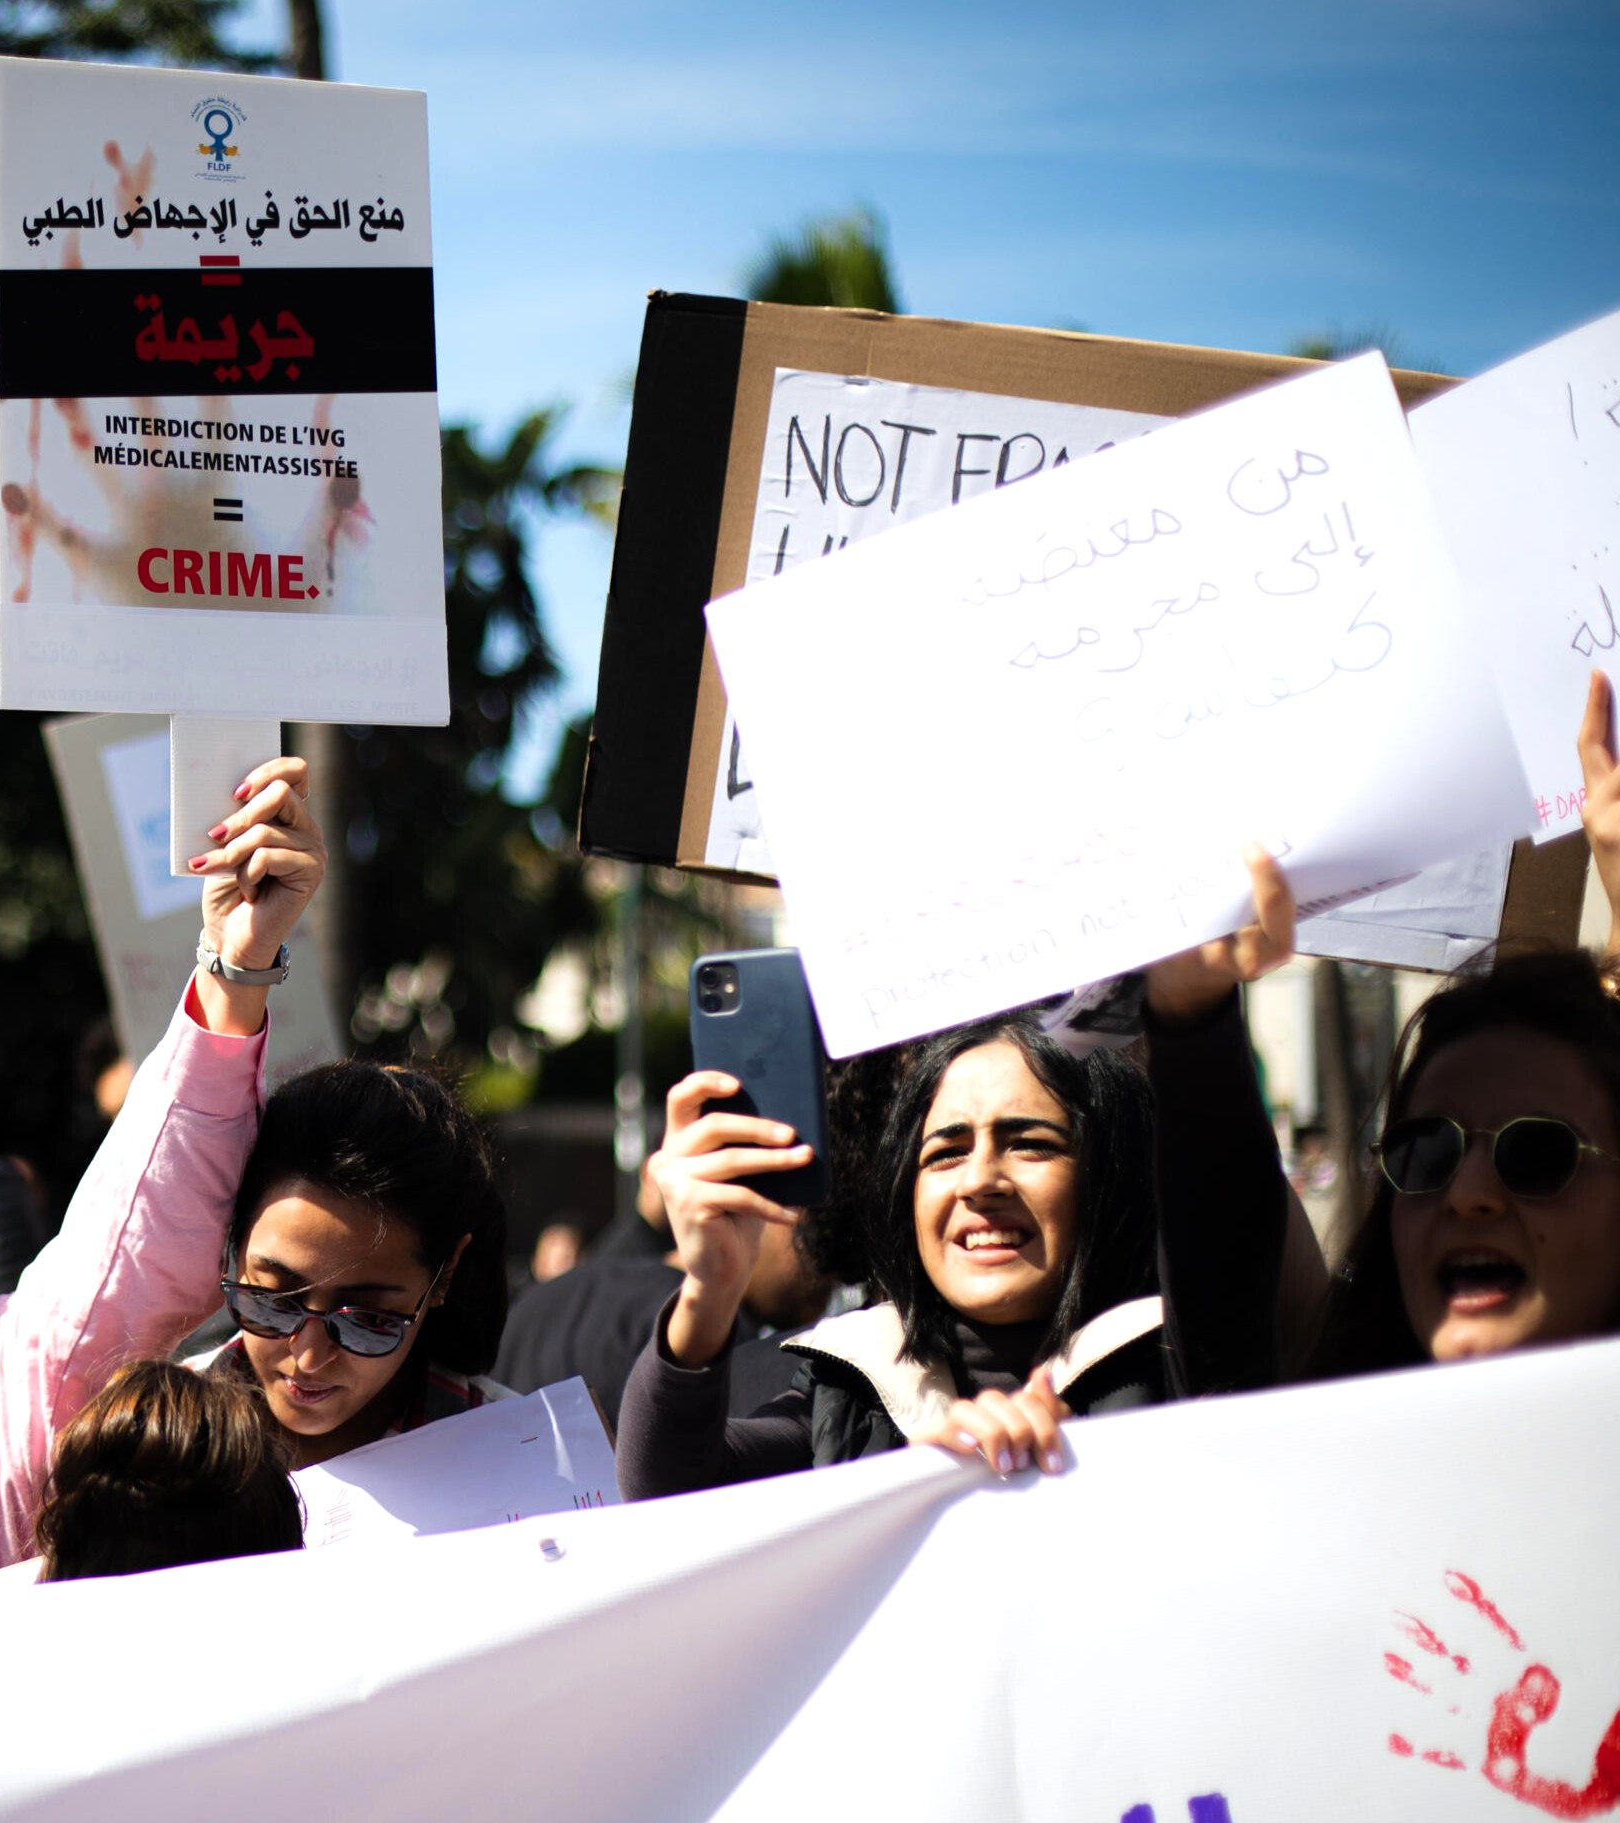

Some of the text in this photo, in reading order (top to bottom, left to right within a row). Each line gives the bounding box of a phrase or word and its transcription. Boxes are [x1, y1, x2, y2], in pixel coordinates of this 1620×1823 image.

[207, 162, 232, 172] FLDF
[21, 190, 405, 248] منع الحق في الإجهاض الطبي
[134, 293, 315, 383] جريمة
[104, 415, 254, 443] INTERDICTION
[259, 424, 287, 444] DE
[783, 412, 938, 516] NOT
[1225, 448, 1331, 517] من
[137, 547, 321, 601] CRIME.
[1253, 499, 1376, 597] إلى
